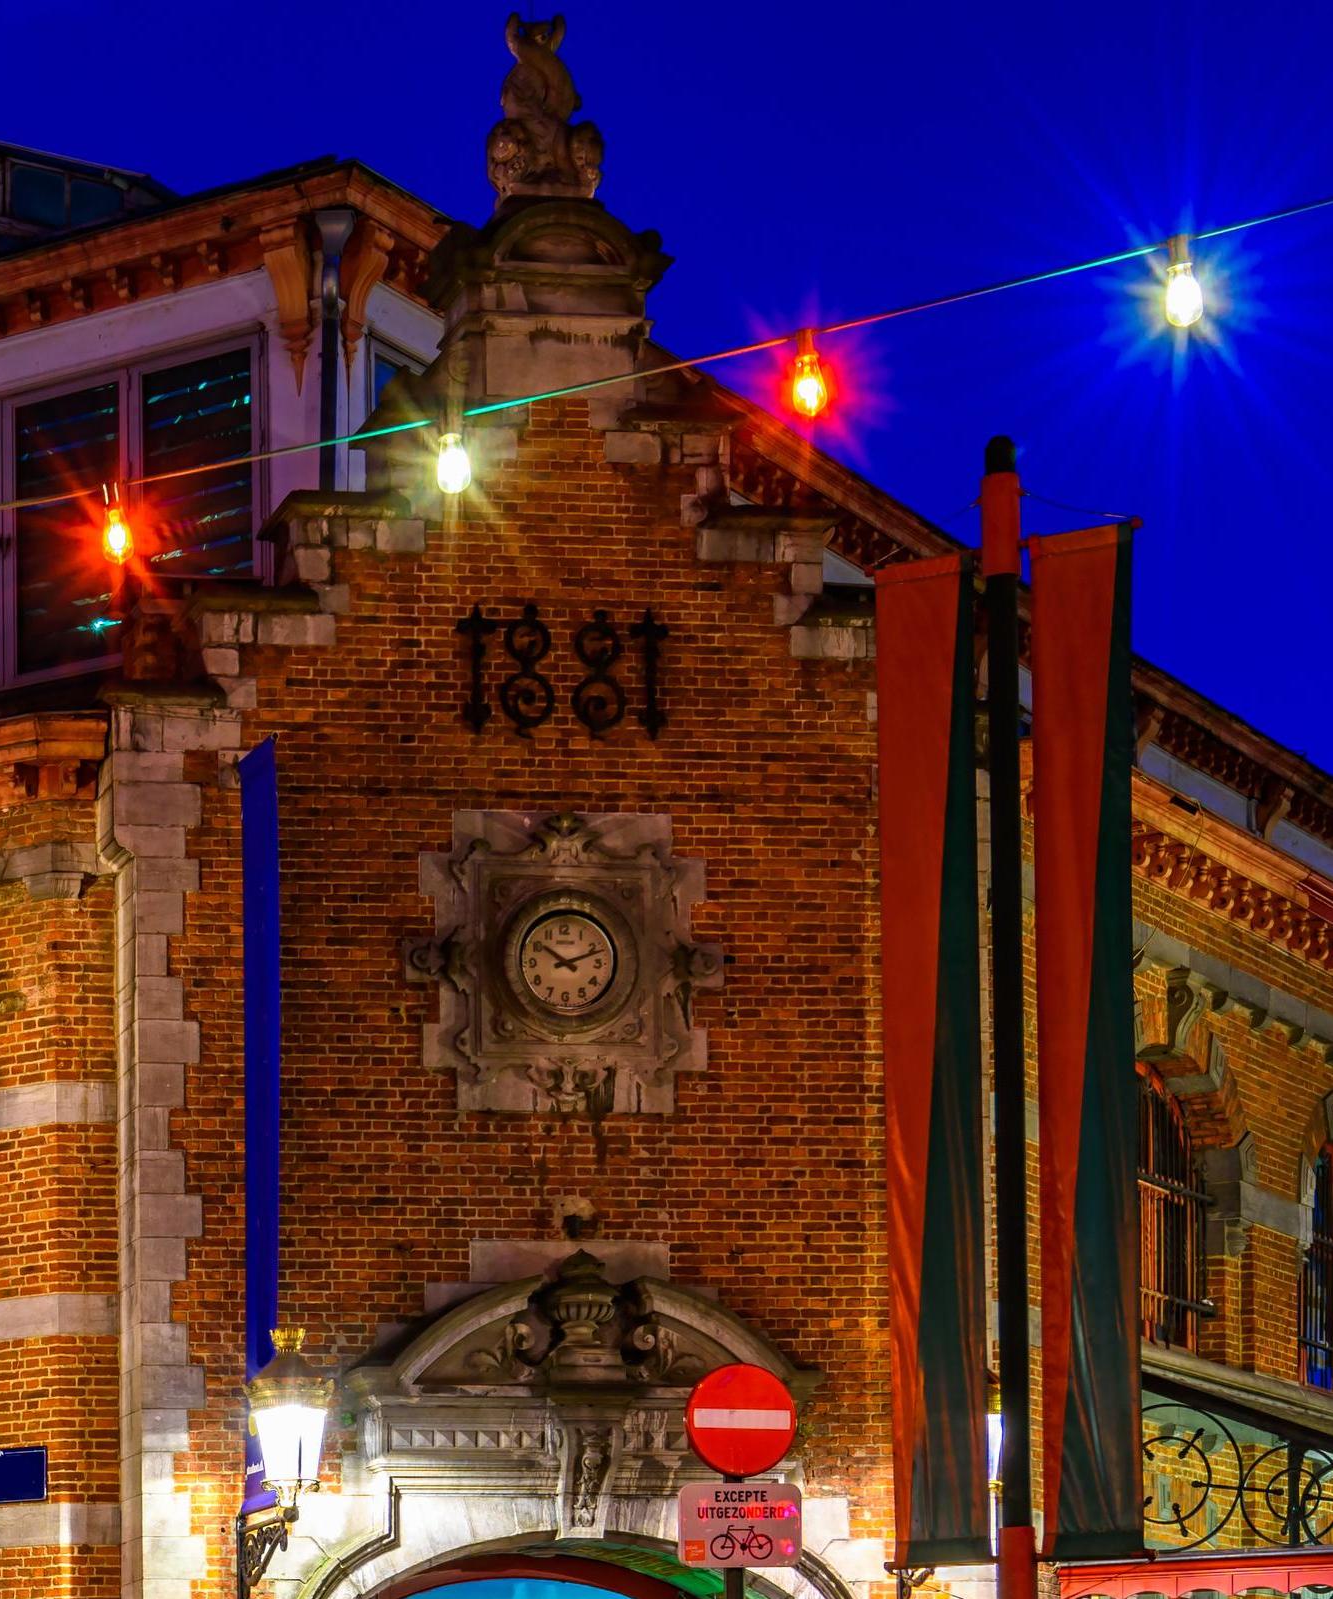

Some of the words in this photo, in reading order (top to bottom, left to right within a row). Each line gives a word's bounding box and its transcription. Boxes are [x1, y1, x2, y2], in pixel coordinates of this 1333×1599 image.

[455, 602, 670, 742] 1881
[544, 929, 553, 940] 11
[559, 924, 570, 936] 12
[529, 958, 537, 969] 9
[594, 958, 602, 970] 3
[534, 974, 542, 986] 8
[588, 975, 598, 987] 4
[546, 986, 554, 998] 7
[561, 991, 570, 1002] 6
[578, 987, 587, 998] 5
[714, 1490, 768, 1503] EXCEPTE
[697, 1506, 785, 1520] UITGEZONDERD
